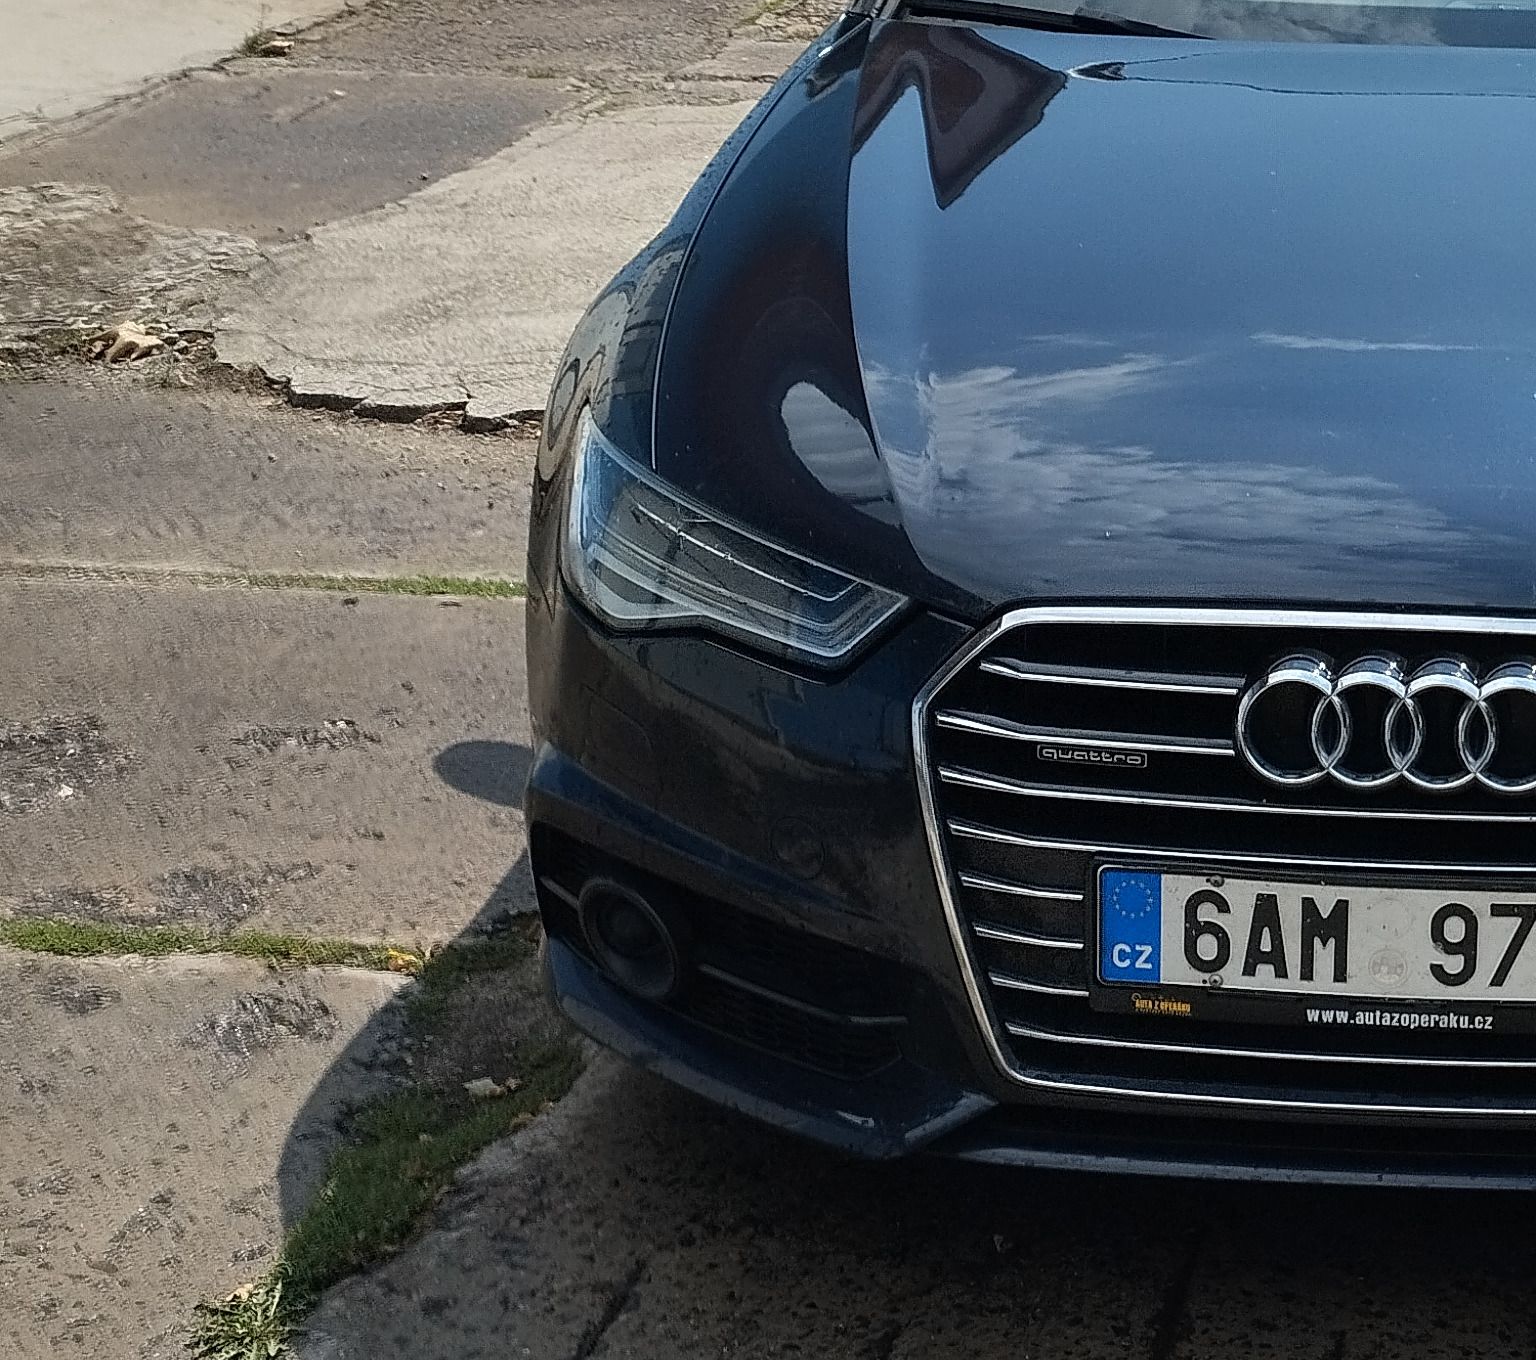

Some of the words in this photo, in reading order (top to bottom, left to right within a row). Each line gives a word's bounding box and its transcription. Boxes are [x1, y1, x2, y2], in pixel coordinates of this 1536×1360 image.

[1042, 748, 1142, 764] quattro
[1183, 888, 1350, 984] 6AM
[1112, 942, 1153, 970] CZ
[1306, 1008, 1494, 1030] www.autazoperaku.cz
